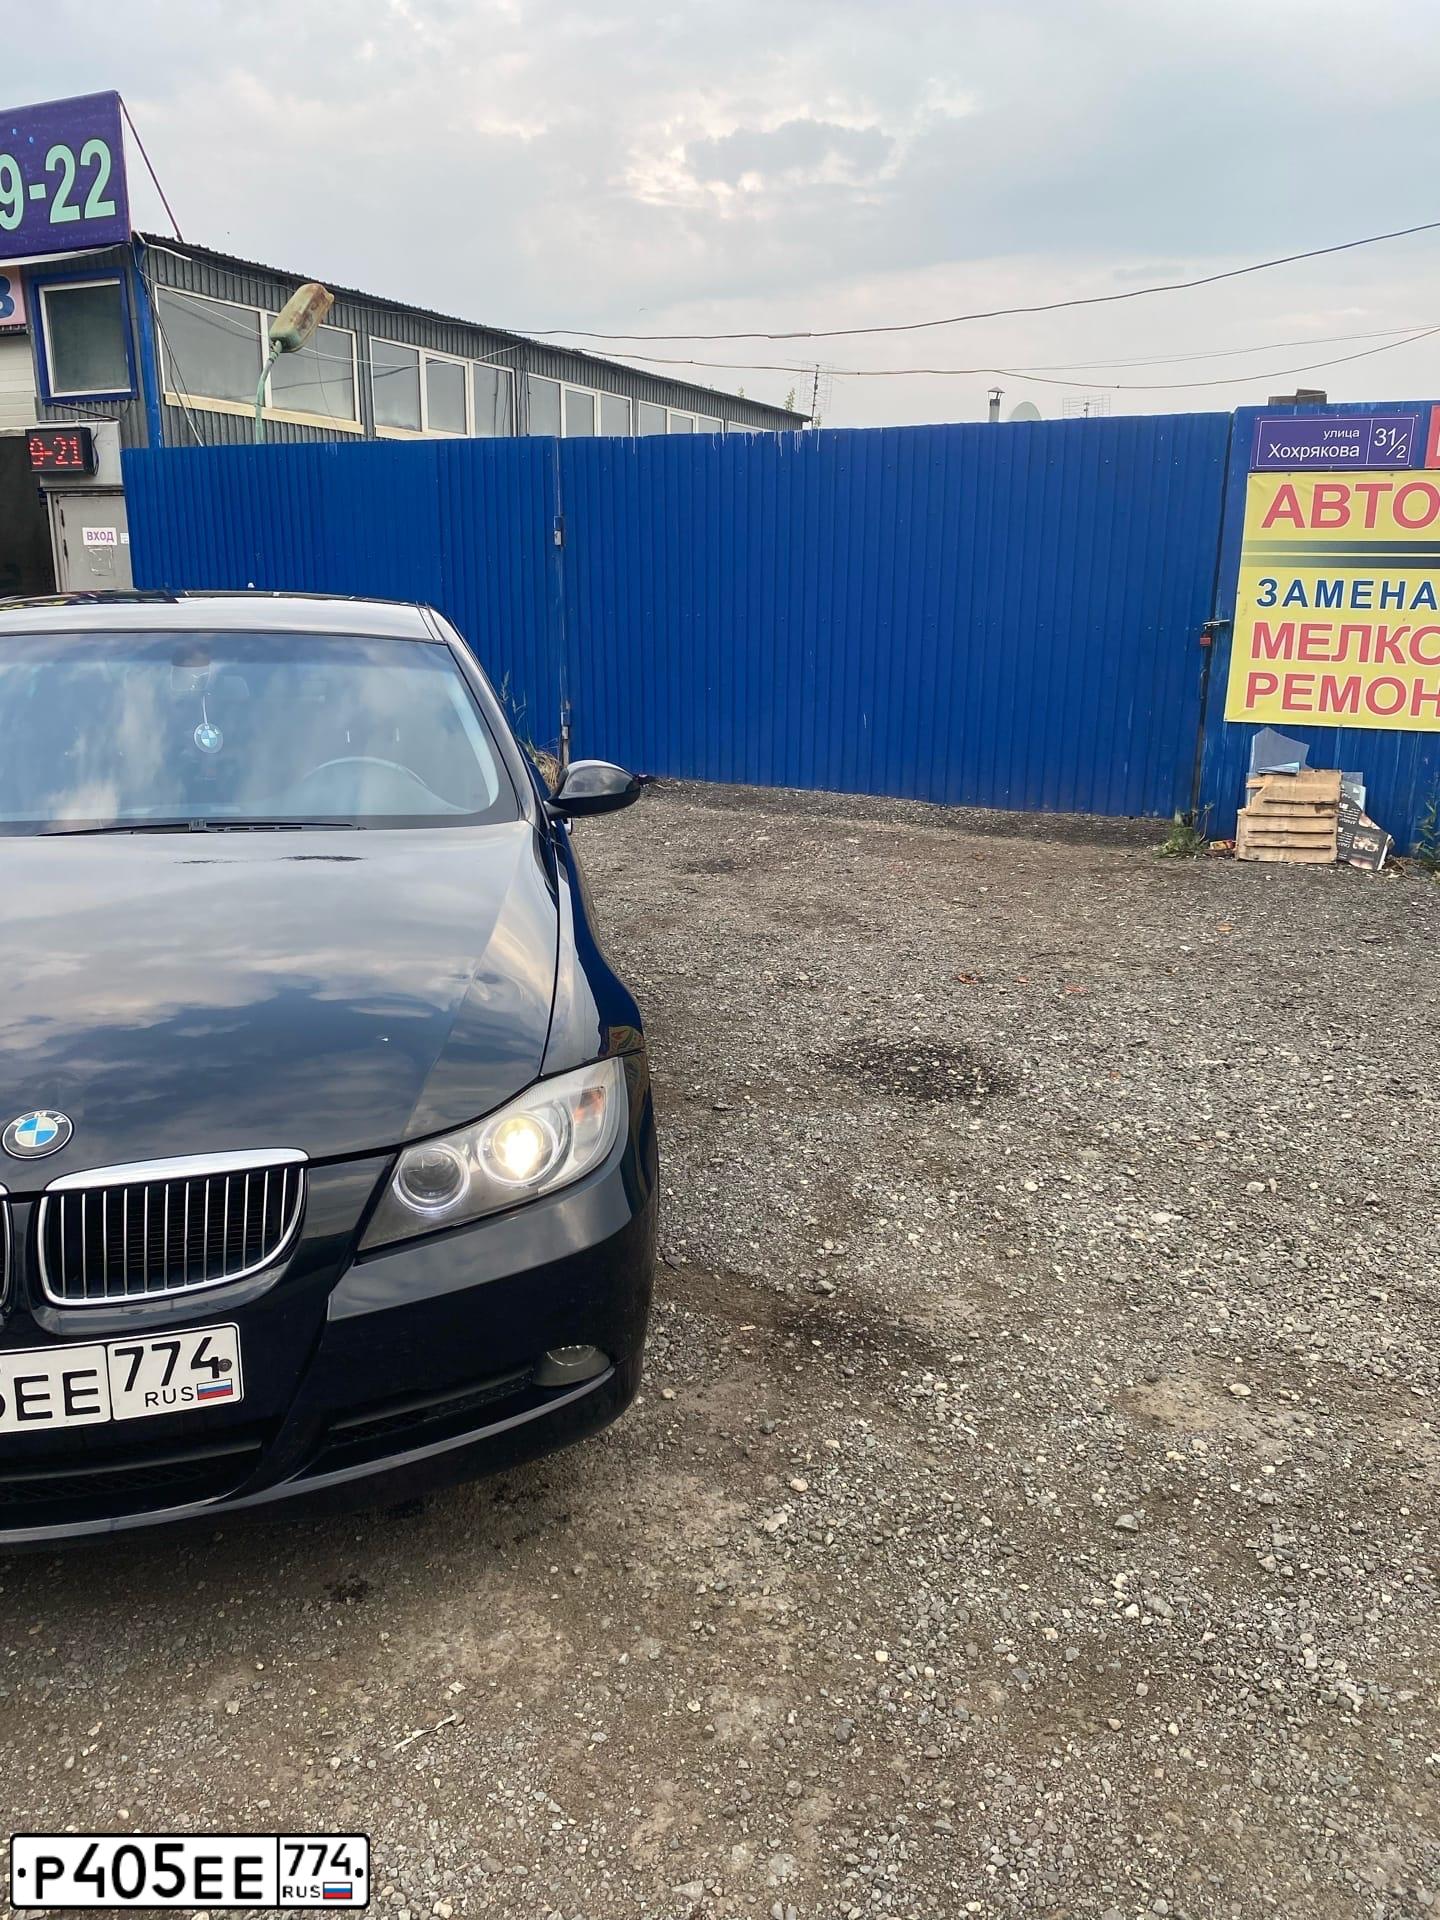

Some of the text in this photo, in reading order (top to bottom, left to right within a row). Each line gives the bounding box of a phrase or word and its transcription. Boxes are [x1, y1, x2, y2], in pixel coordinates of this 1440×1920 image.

[1323, 429, 1360, 440] улица
[1268, 443, 1360, 461] Хохрякова
[1261, 482, 1440, 529] АВТО
[86, 531, 114, 543] ВХОД
[1256, 579, 1438, 610] ЗАМЕНА
[115, 1337, 219, 1392] 774
[145, 1386, 194, 1407] RUS
